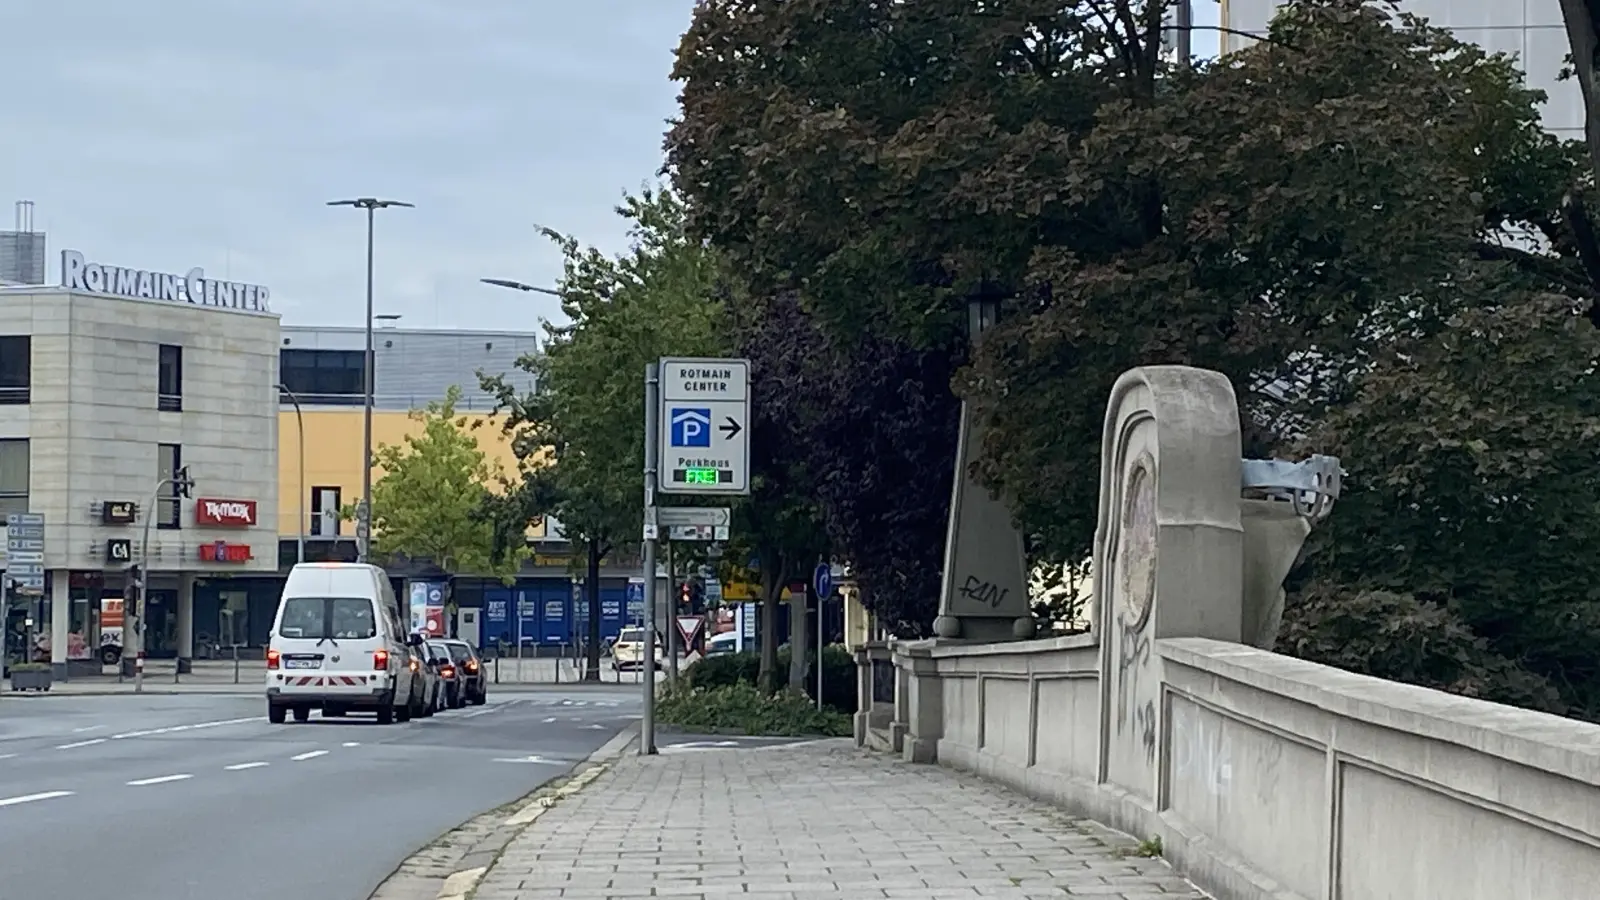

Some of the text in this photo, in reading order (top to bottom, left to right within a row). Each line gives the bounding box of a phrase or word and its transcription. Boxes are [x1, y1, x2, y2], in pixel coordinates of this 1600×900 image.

[680, 369, 731, 379] ROTMAIN
[684, 381, 727, 392] CENTER
[678, 457, 730, 468] Parkhaus
[685, 469, 719, 484] FREI
